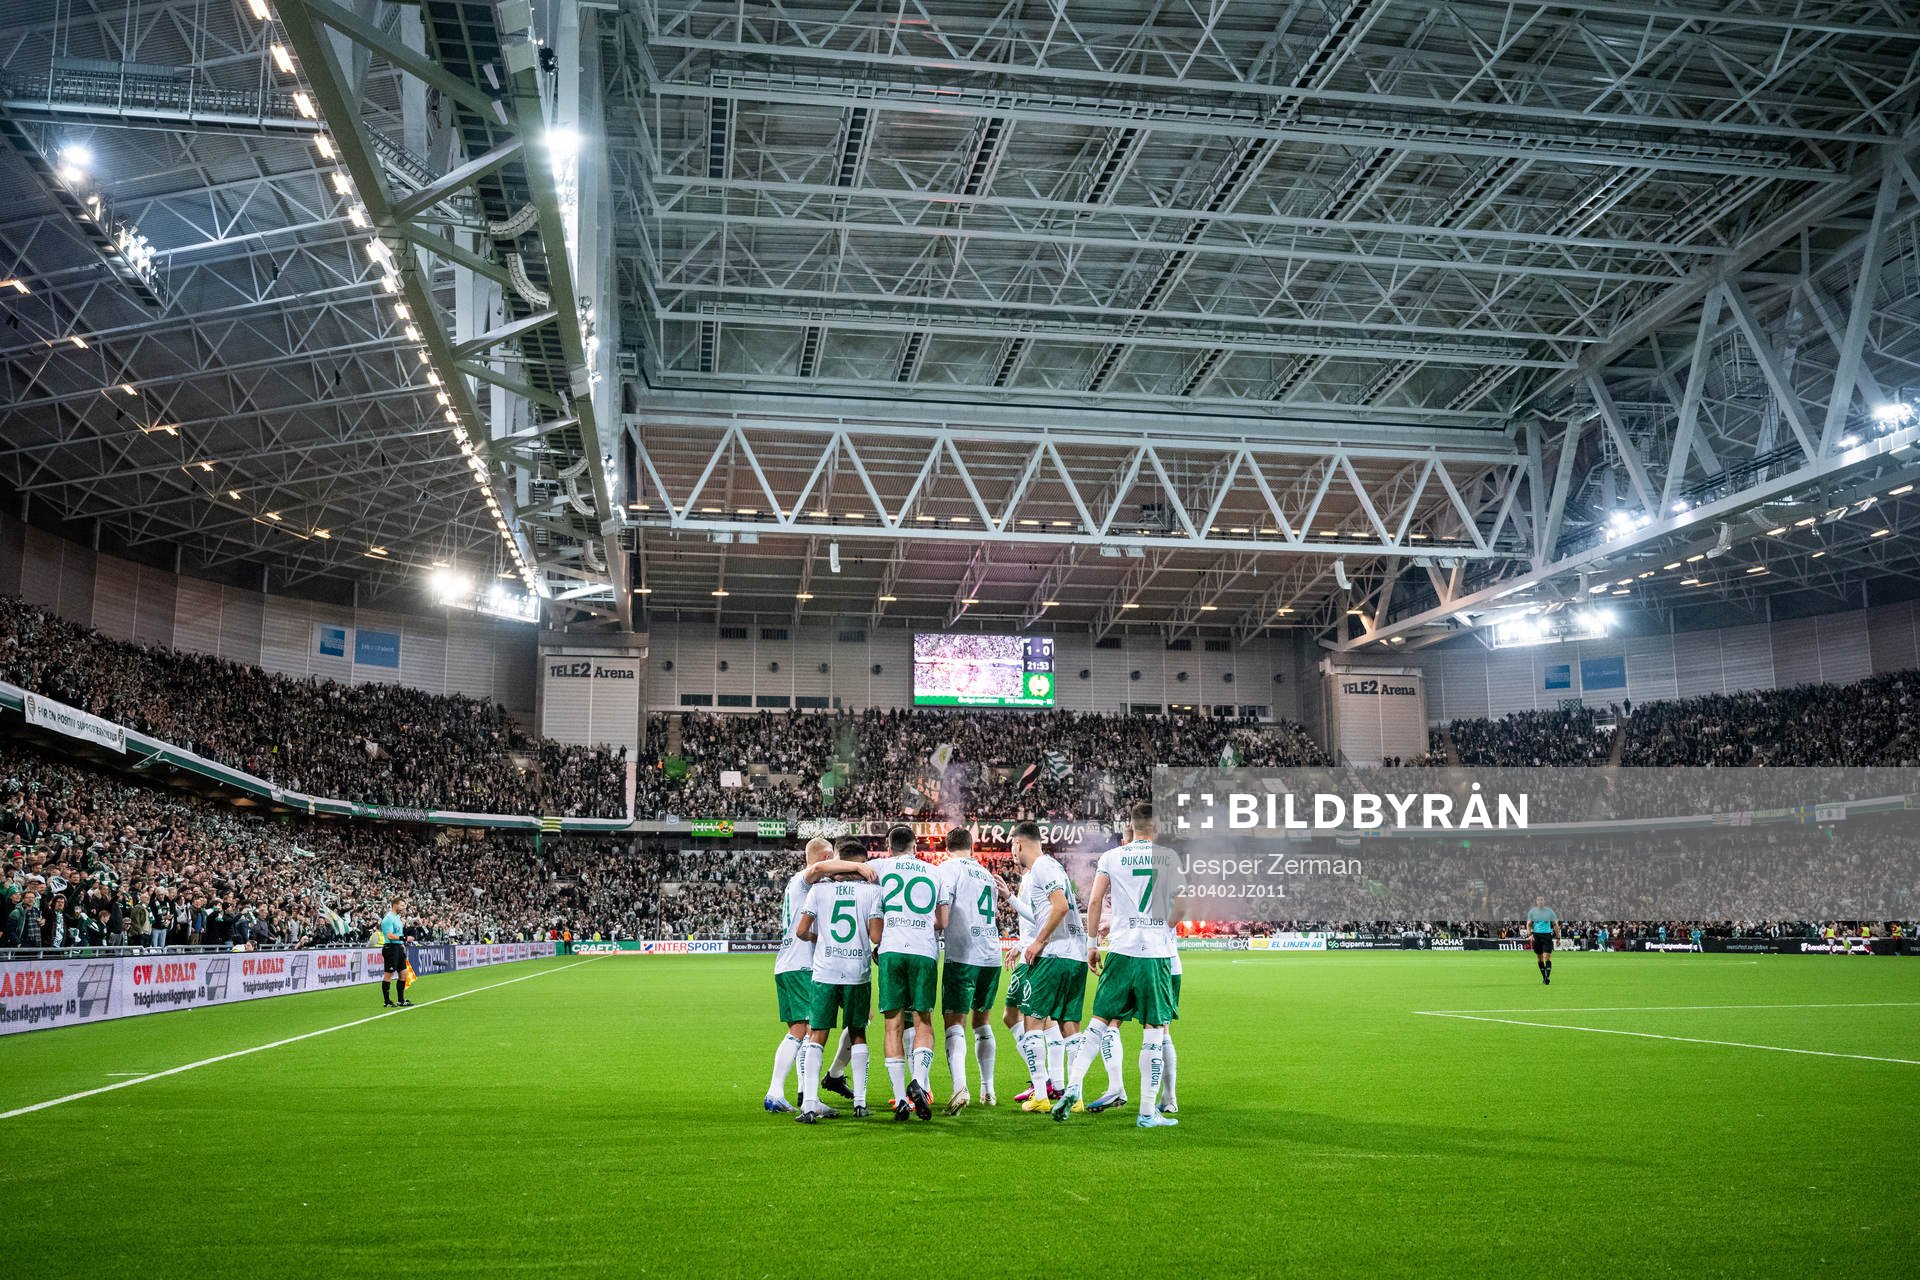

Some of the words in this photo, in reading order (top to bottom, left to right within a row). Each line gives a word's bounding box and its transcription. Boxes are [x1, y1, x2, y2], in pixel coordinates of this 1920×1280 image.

[550, 662, 592, 677] TELE2
[594, 666, 635, 679] Arena
[1026, 662, 1050, 671] 21:53
[1343, 680, 1379, 694] TELE2
[1381, 684, 1416, 696] Arena
[895, 862, 927, 874] BESARA
[835, 885, 855, 896] TEKIE
[881, 873, 936, 915] 20
[1132, 868, 1159, 913] 7
[977, 885, 995, 925] 4
[830, 899, 857, 944] 5
[895, 917, 926, 928] PROJOB
[1136, 917, 1164, 926] PROJOB
[572, 944, 611, 952] CRAFT
[654, 942, 723, 951] INTERSPORT
[1272, 940, 1282, 948] EL
[1312, 941, 1323, 949] AB
[1340, 941, 1374, 949] digipant.se
[1431, 938, 1464, 946] SASCHAS
[832, 947, 863, 958] PROJOB
[242, 959, 255, 976] GW
[256, 958, 285, 975] ASFALT
[317, 955, 327, 970] GW
[327, 954, 347, 969] ASFALT
[133, 964, 154, 986] GW
[155, 962, 197, 983] ASFALT
[0, 969, 64, 998] ASFALT
[133, 988, 197, 1007] Trädgårdsanläggningar
[197, 985, 206, 998] AB
[65, 999, 76, 1015] AB
